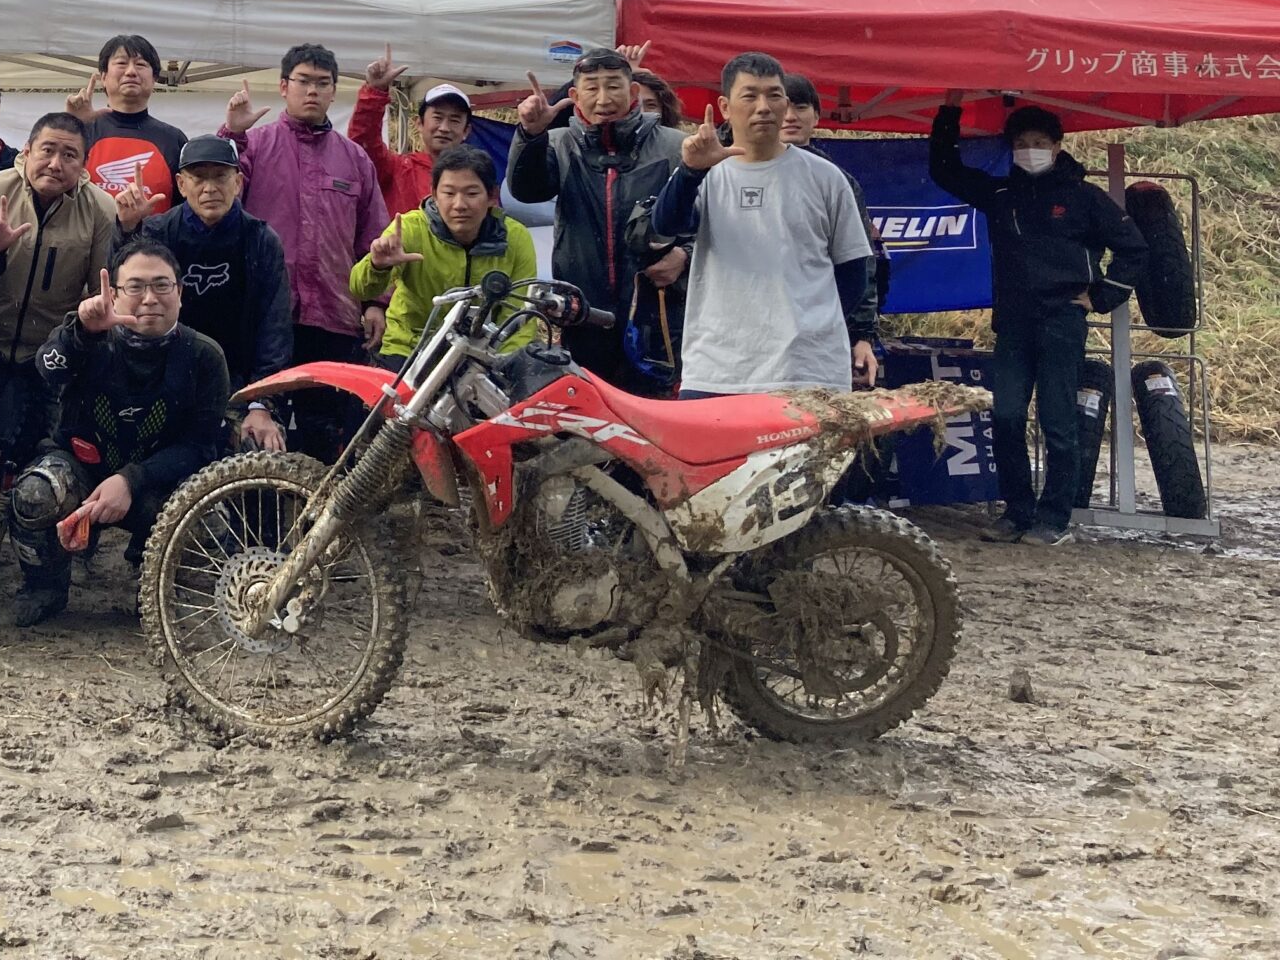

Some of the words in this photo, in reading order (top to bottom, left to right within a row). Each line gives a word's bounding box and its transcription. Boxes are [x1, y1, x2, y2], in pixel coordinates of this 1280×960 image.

[96, 182, 152, 195] HONA
[872, 213, 969, 239] ELIN
[756, 425, 814, 444] HONDA
